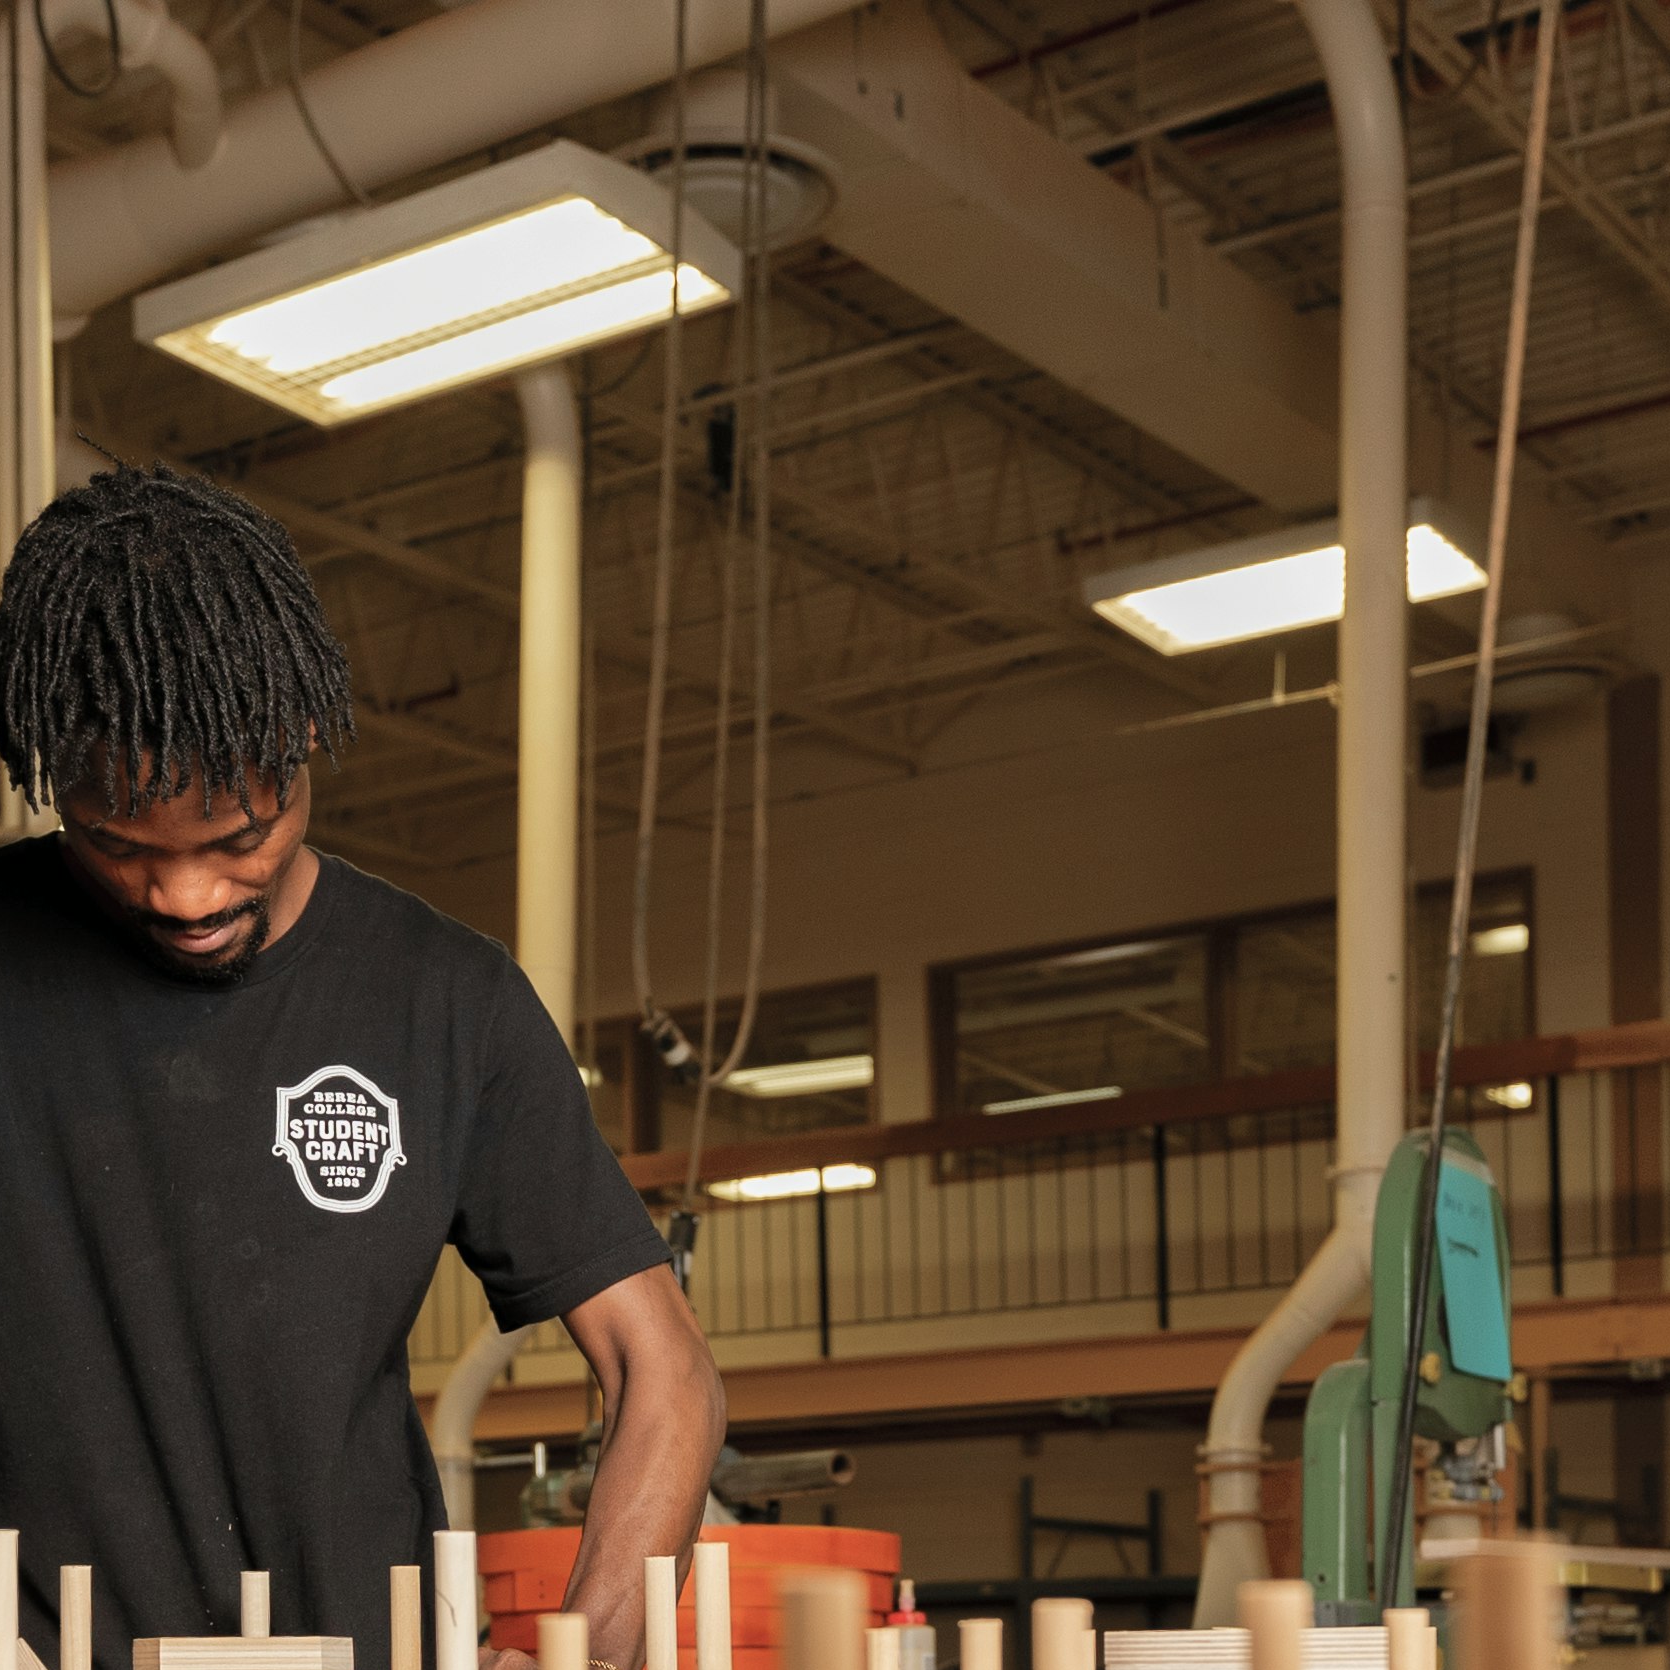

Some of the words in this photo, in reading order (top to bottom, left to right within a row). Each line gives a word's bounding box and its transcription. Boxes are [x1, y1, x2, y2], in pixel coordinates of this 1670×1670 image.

[313, 1092, 367, 1104] BEREA
[304, 1103, 376, 1117] COLLEGE
[290, 1118, 389, 1145] STUDENT
[305, 1141, 379, 1163] CRAFT
[319, 1166, 366, 1178] SINCE
